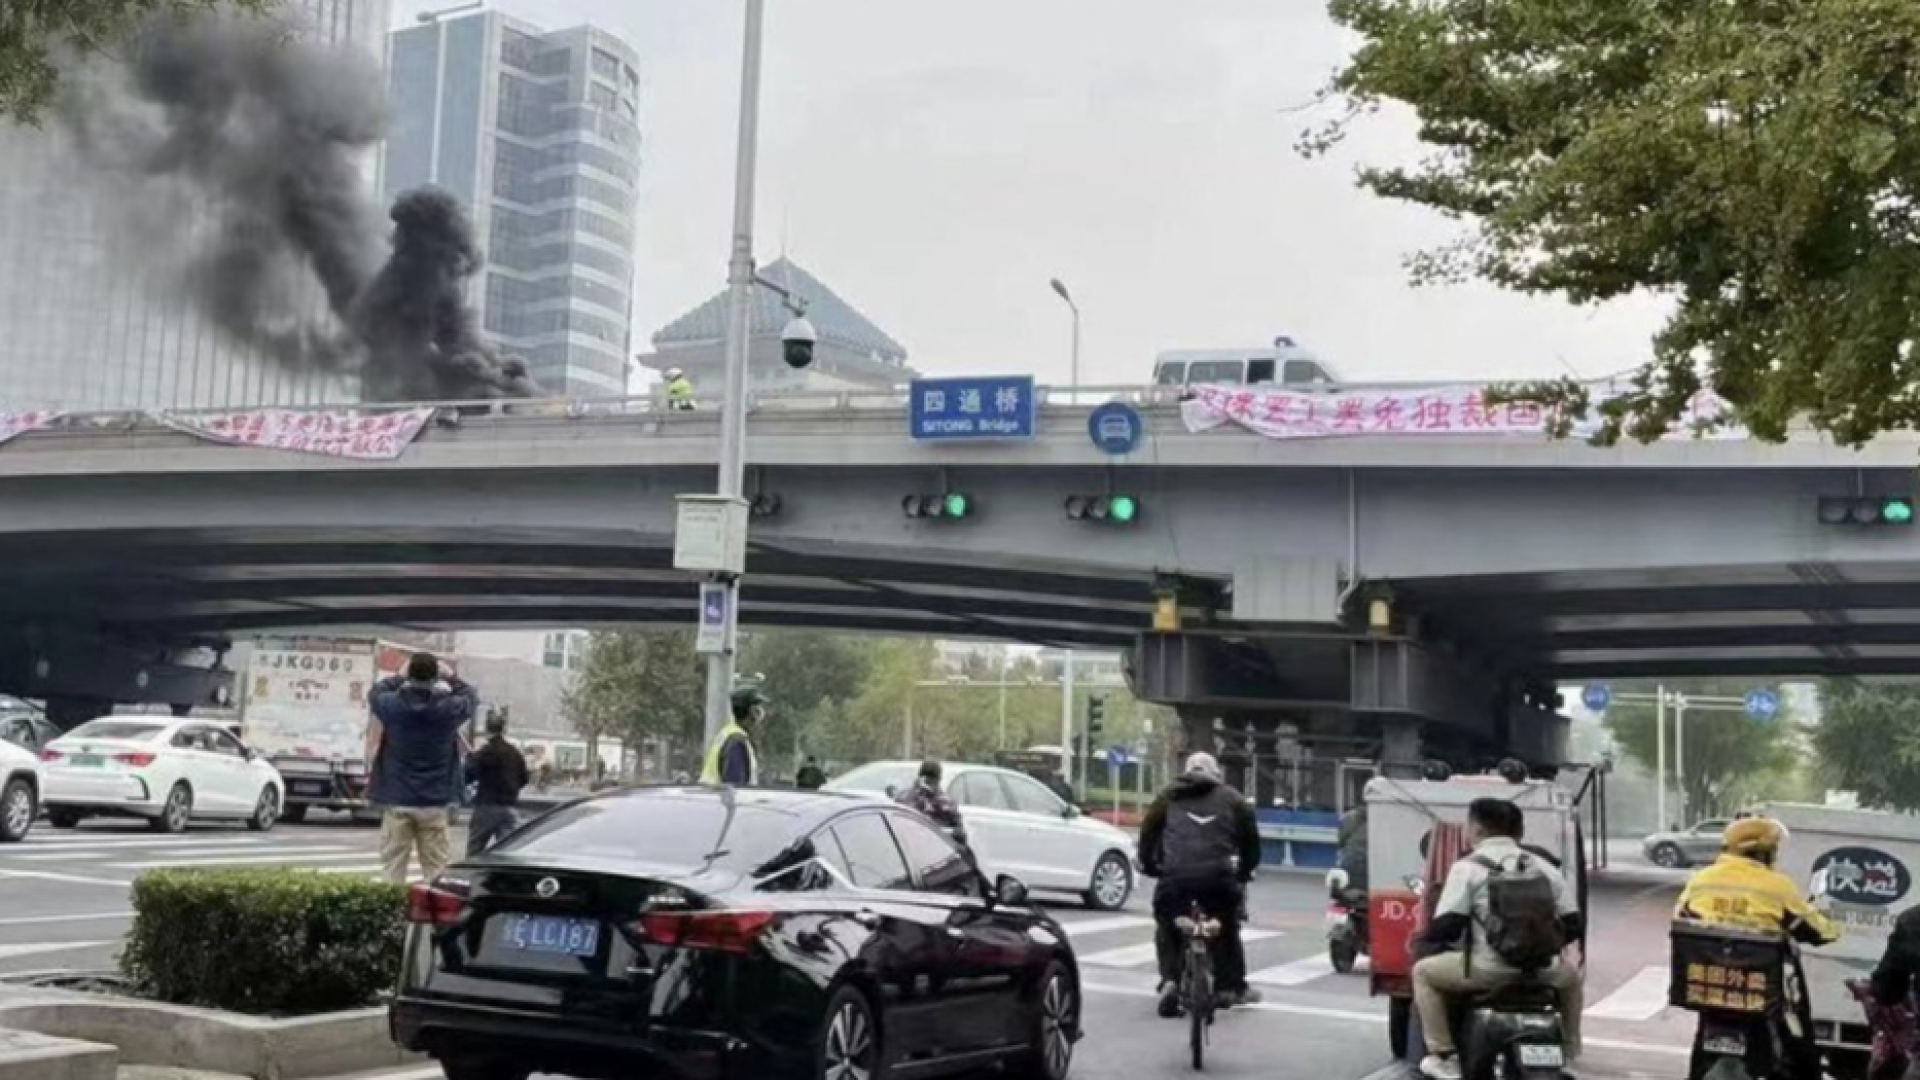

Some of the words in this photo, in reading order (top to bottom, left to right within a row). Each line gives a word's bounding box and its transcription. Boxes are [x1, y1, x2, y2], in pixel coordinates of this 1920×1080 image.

[923, 386, 1019, 412] 四通桥
[922, 420, 973, 433] SITONG
[979, 419, 1019, 433] Bridge
